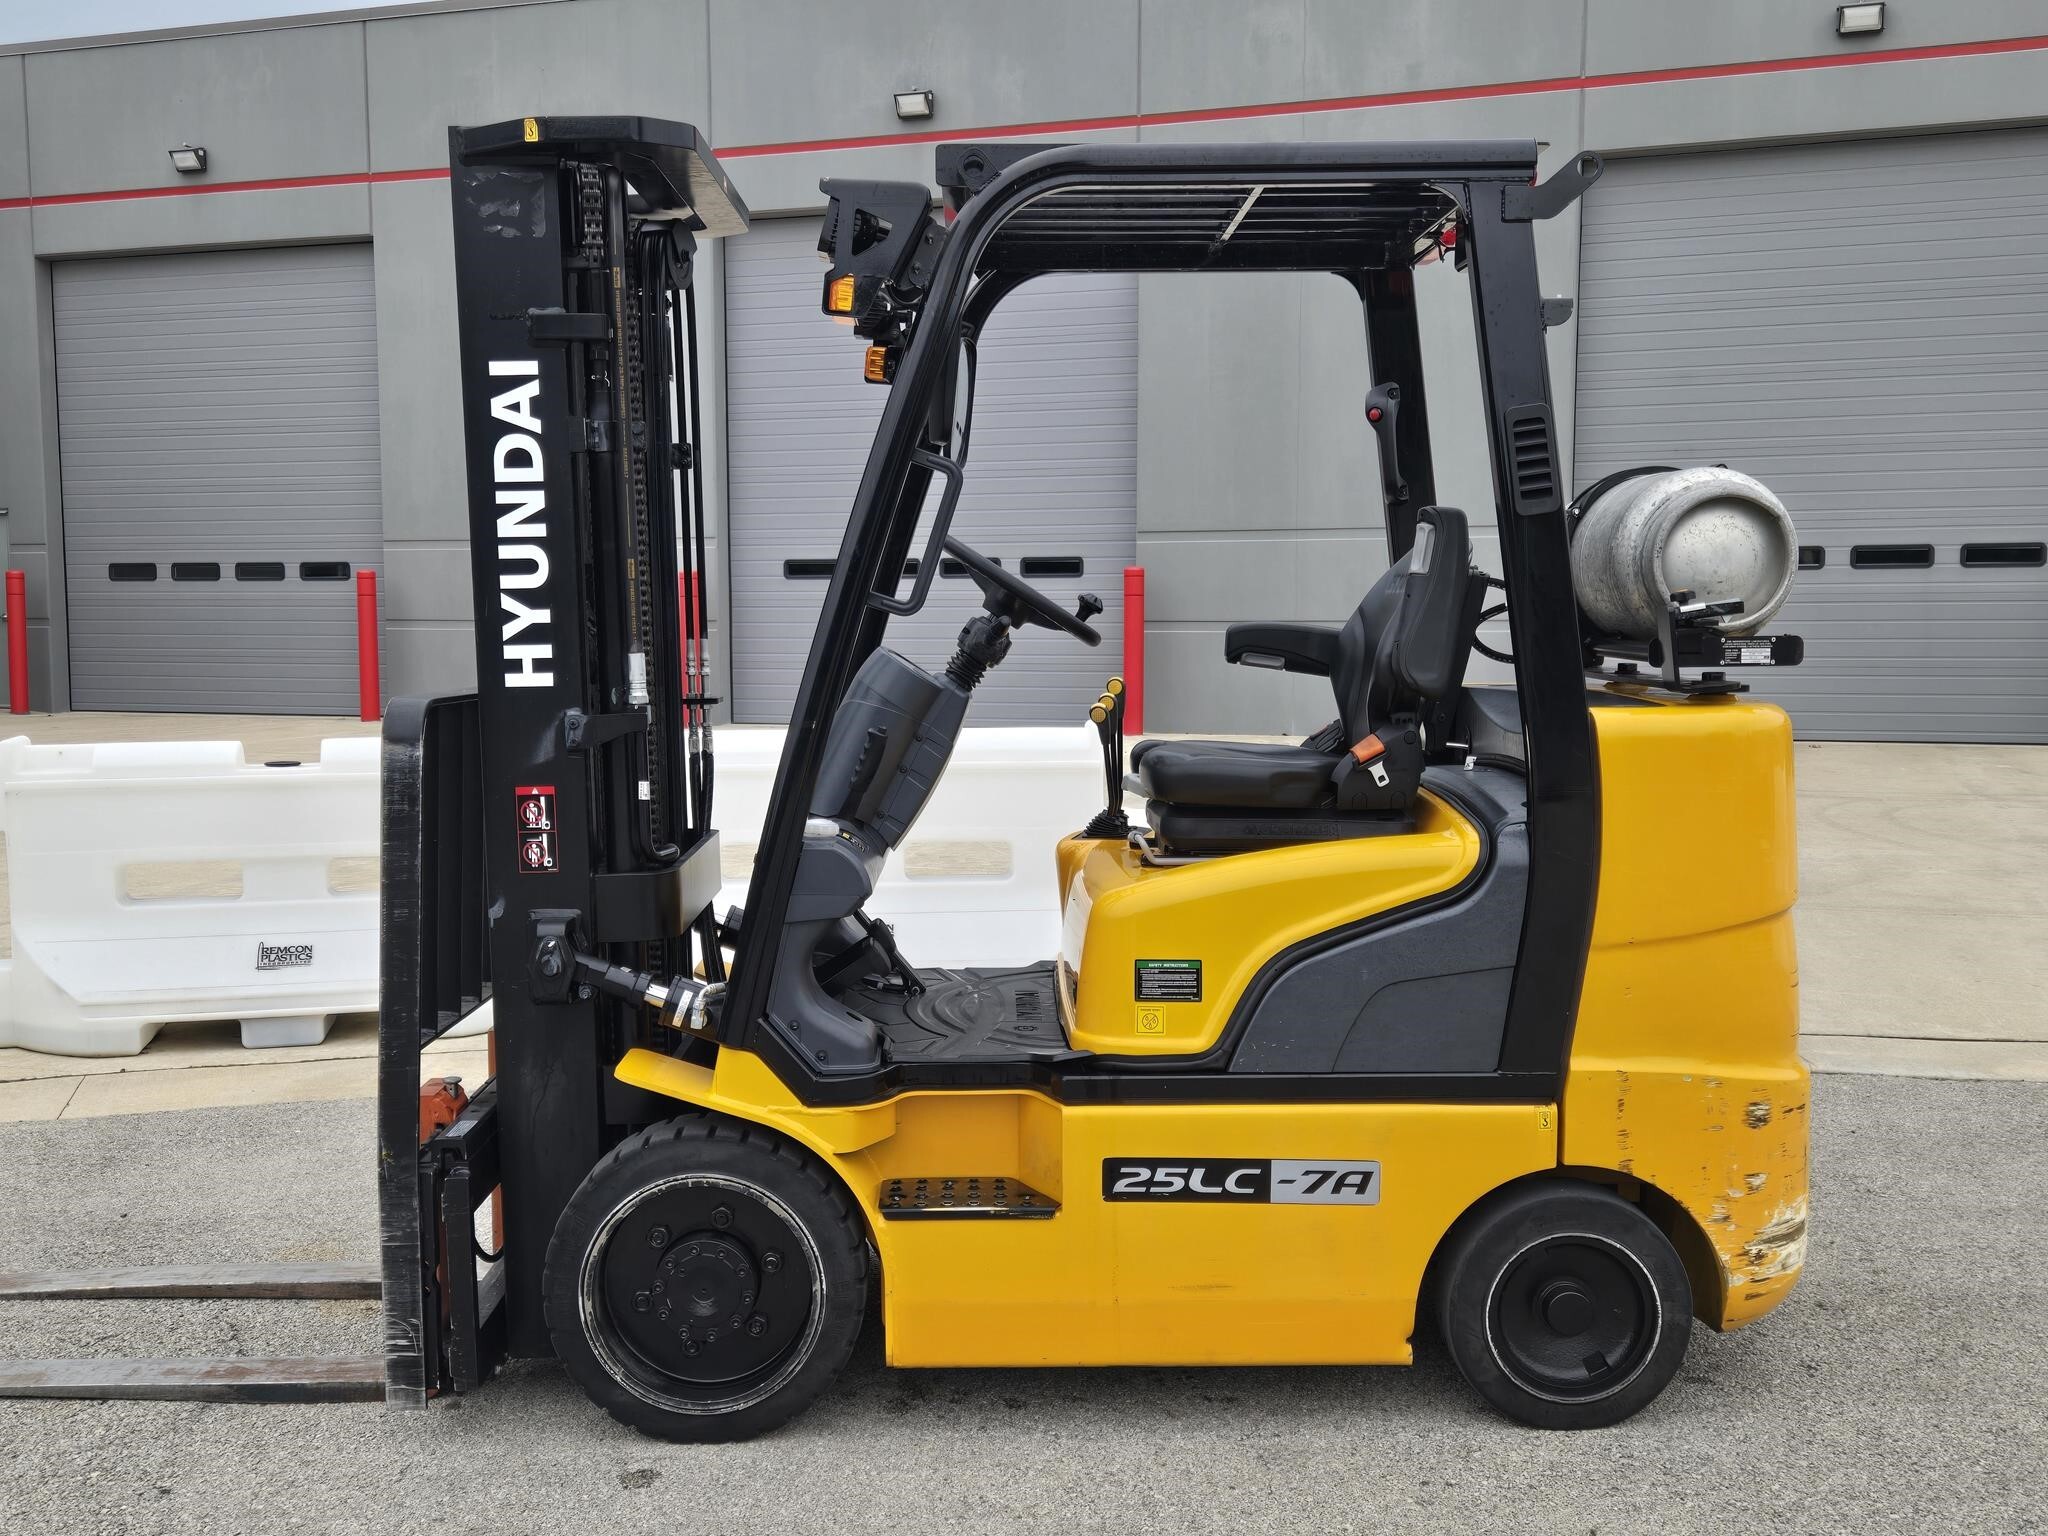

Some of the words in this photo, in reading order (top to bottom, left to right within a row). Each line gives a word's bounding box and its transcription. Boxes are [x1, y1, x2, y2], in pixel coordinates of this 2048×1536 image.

[488, 360, 554, 687] HYUNDAI
[261, 945, 313, 955] REMCON
[261, 952, 313, 963] PLASTICS
